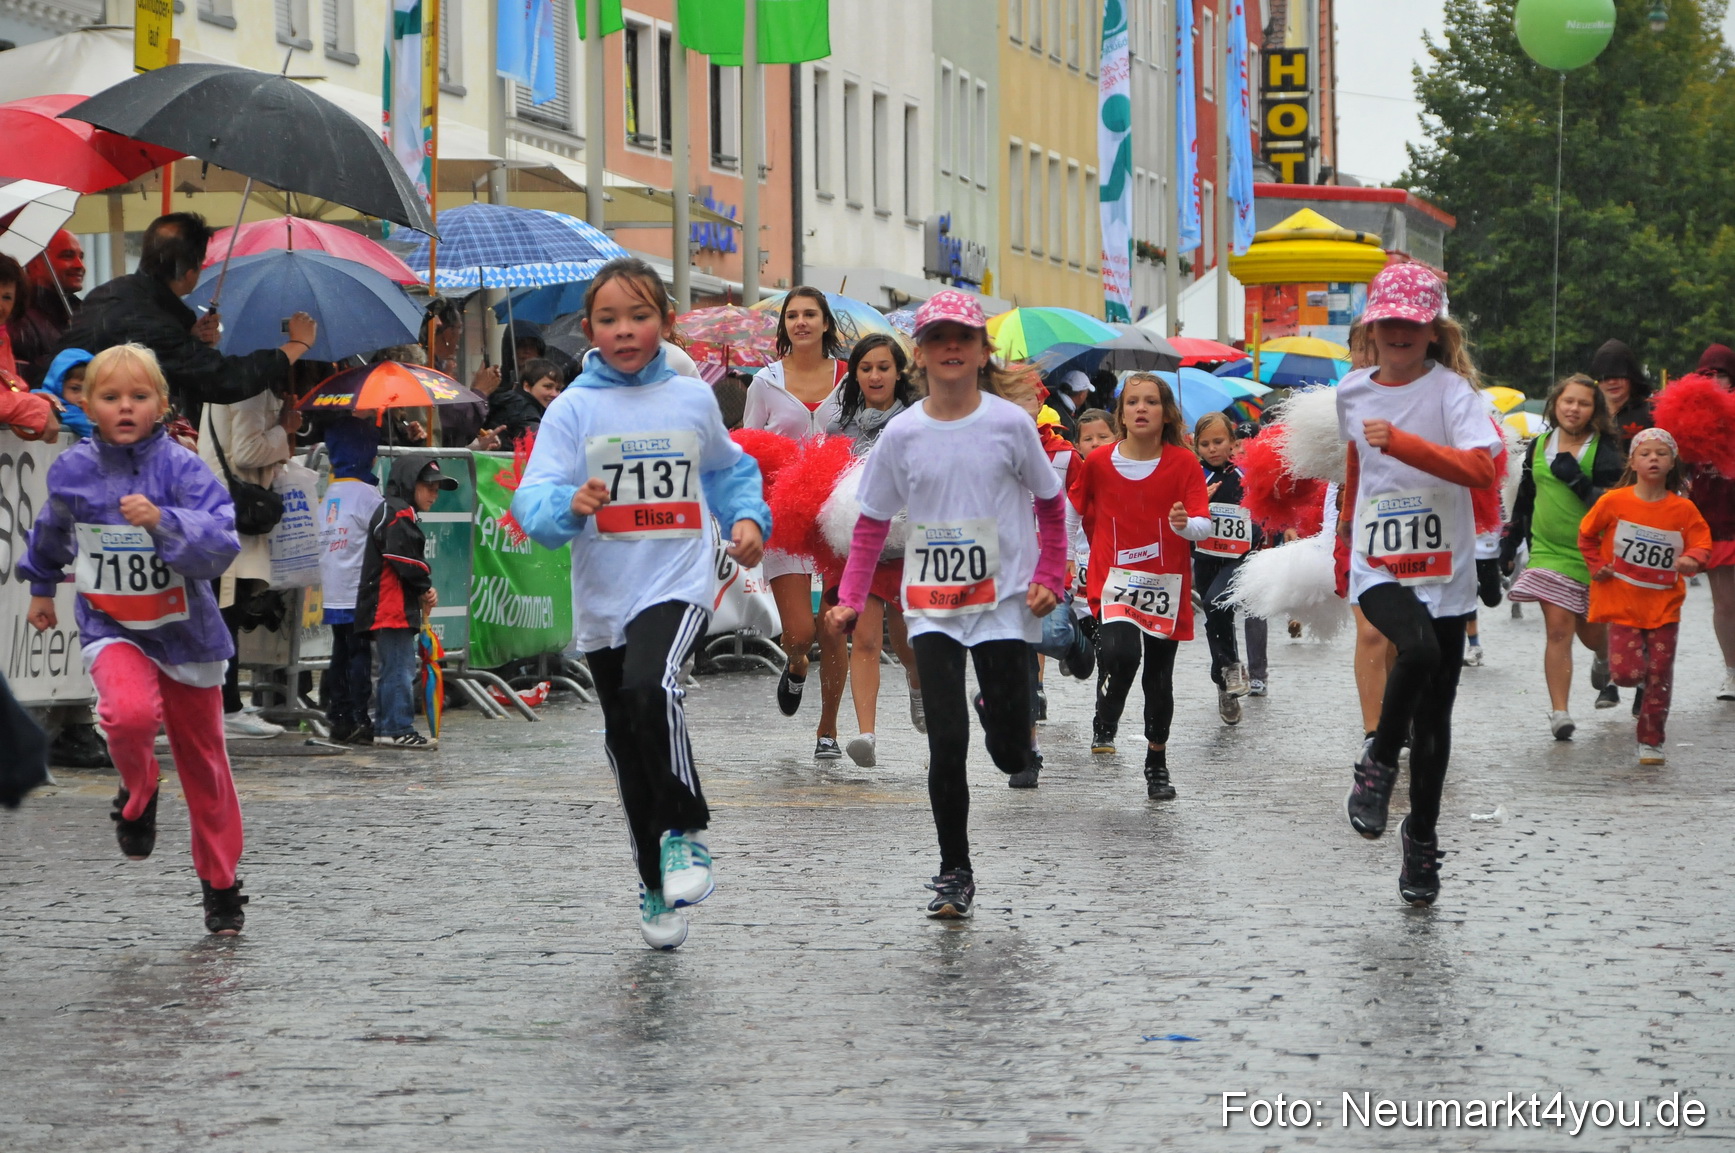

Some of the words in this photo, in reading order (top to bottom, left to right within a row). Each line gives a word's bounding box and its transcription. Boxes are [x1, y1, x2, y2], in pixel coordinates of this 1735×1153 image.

[621, 438, 671, 453] BOCK
[602, 460, 691, 501] 7137
[1377, 496, 1423, 512] BOCK
[634, 509, 674, 527] Elisa
[926, 528, 963, 540] BOCK
[1212, 517, 1245, 540] 138
[1365, 514, 1442, 556] 7019
[101, 532, 144, 545] BOCK
[1214, 541, 1228, 550] Eva
[1129, 550, 1148, 560] DEHN
[1622, 538, 1674, 569] 7368
[90, 552, 170, 592] 7188
[915, 545, 987, 583] 7020
[1389, 559, 1427, 575] ouisa
[929, 590, 968, 606] Sarah
[1114, 586, 1170, 615] 7123
[1124, 608, 1153, 629] Karina
